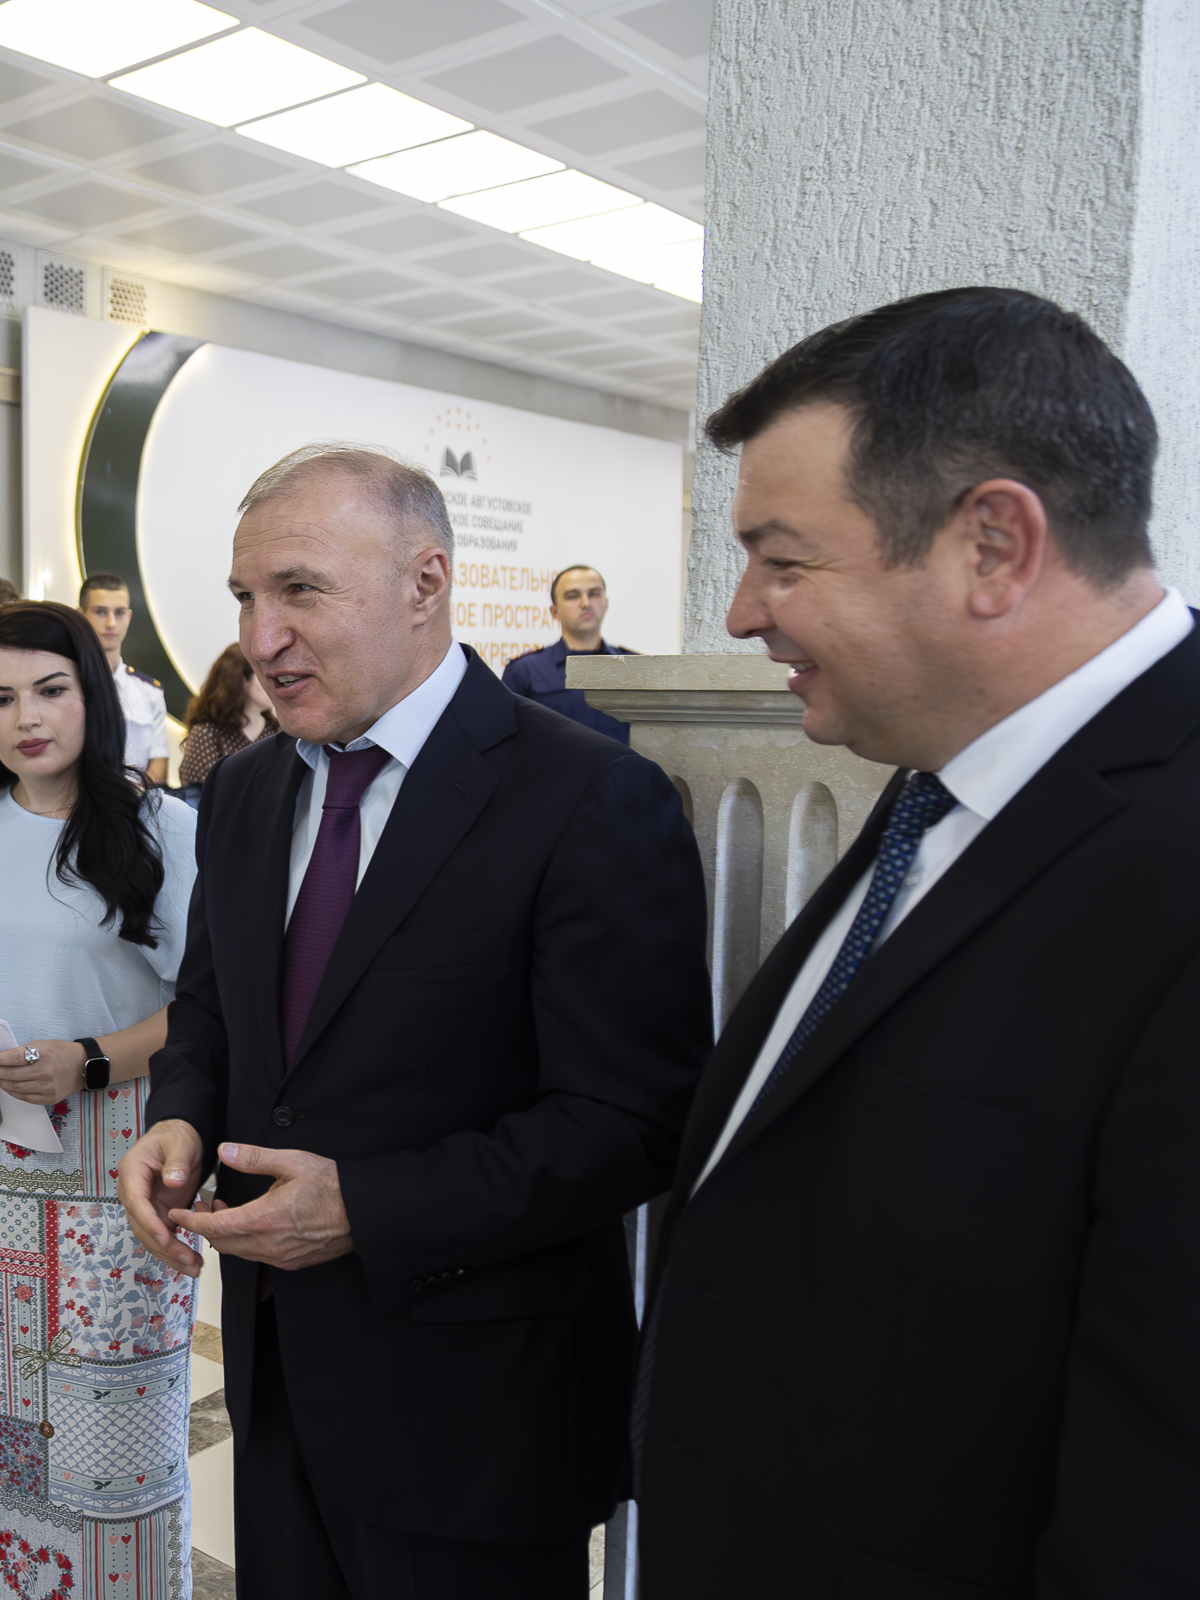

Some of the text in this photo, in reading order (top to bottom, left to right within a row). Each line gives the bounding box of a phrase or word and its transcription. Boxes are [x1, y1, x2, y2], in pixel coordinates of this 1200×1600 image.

[471, 495, 532, 515] АВГУСТОВСКОЕ
[472, 514, 524, 534] СОВЕЩАНИЕ
[457, 533, 518, 552] ОБРАЗОВАНИЯ
